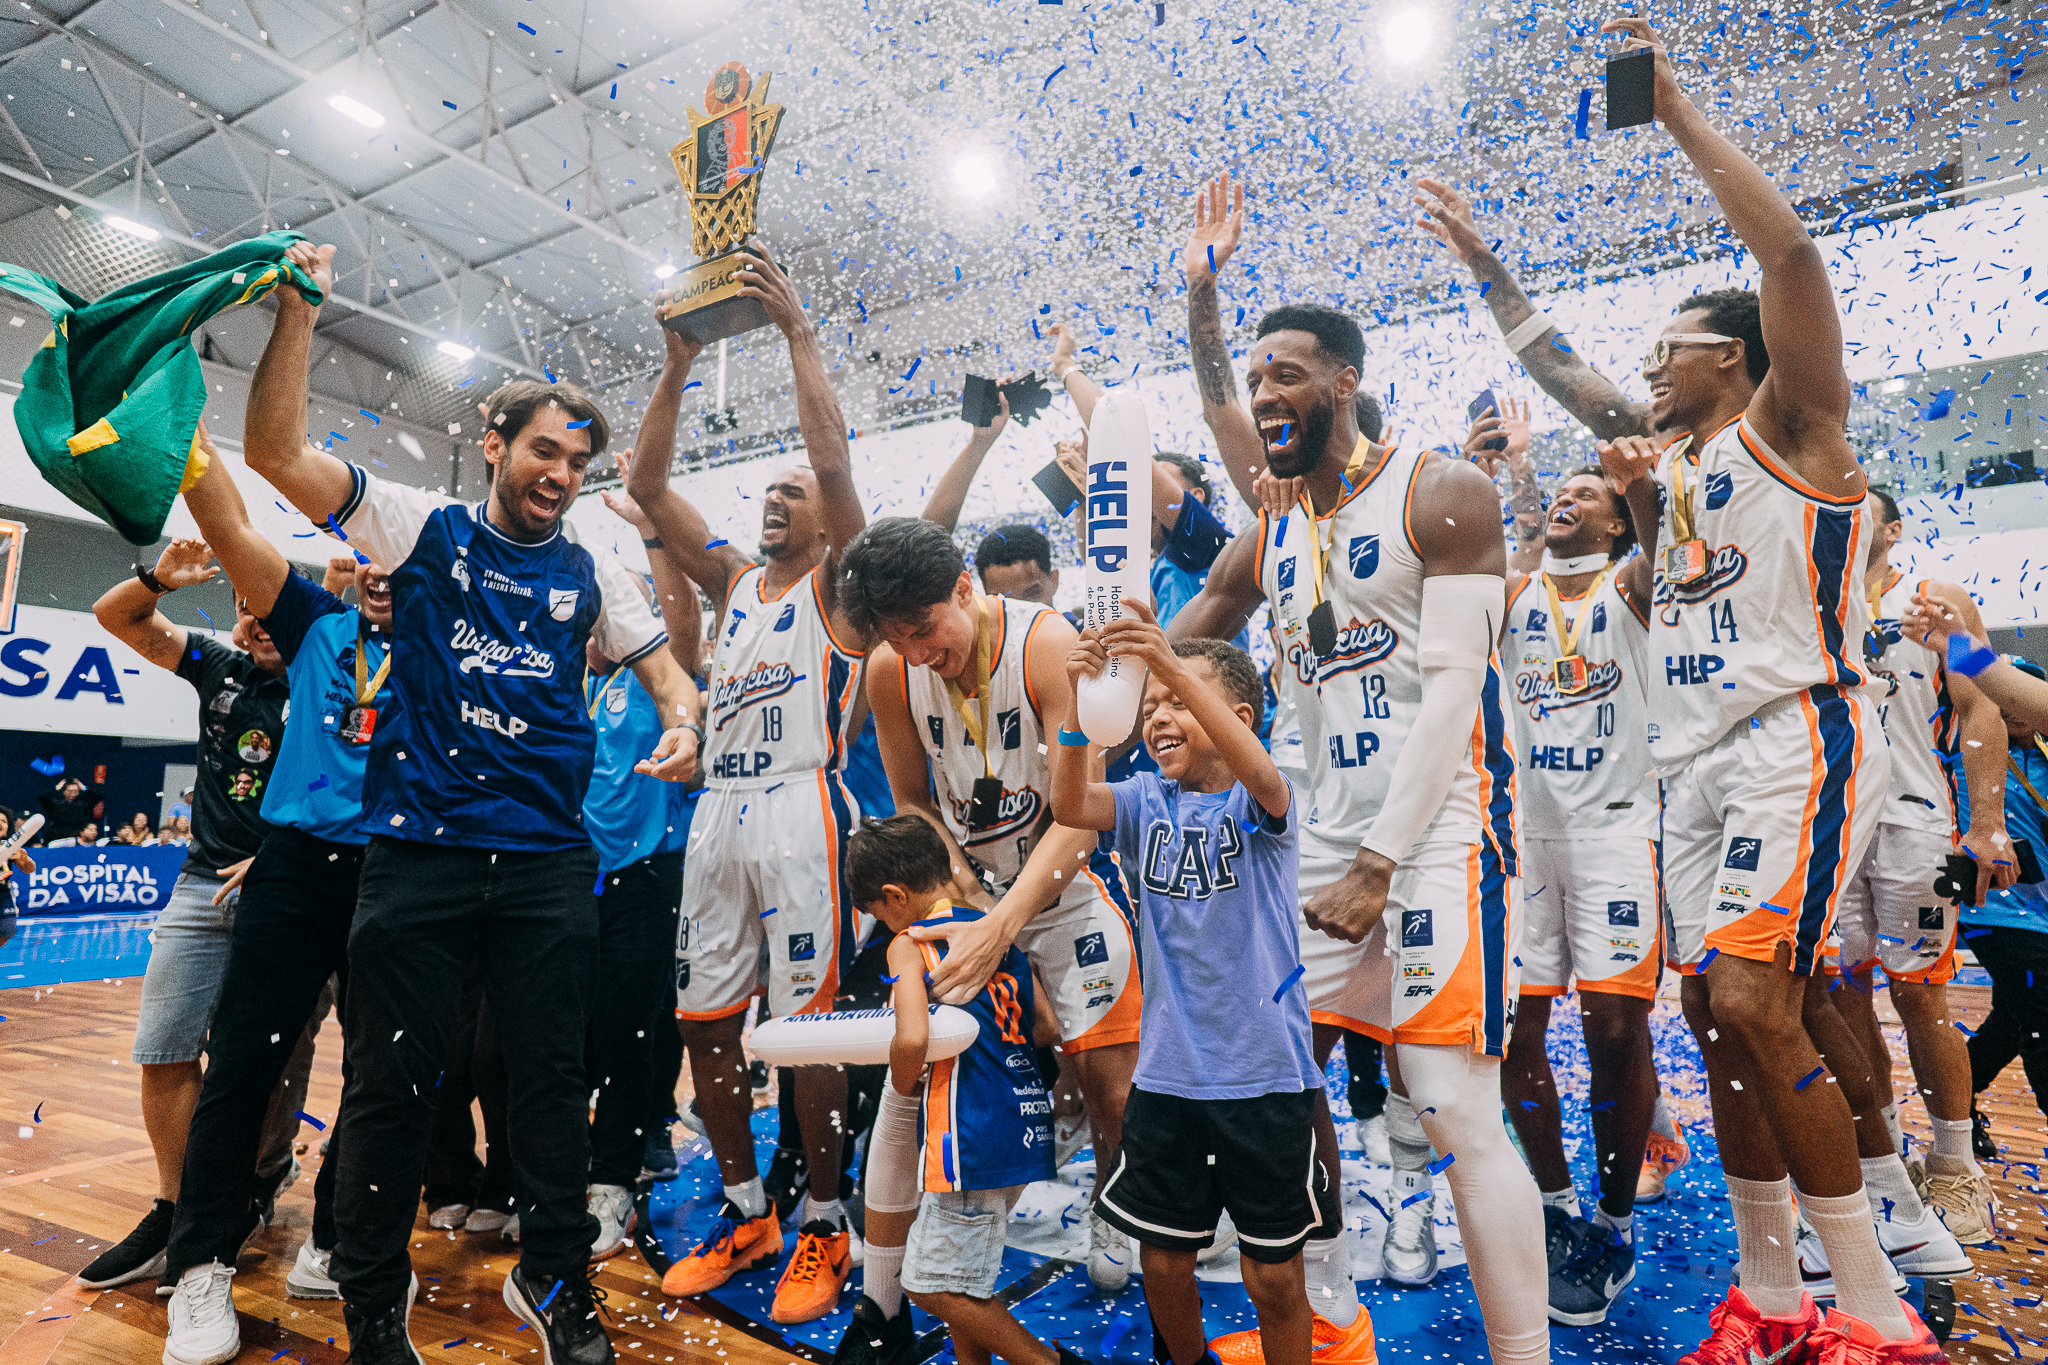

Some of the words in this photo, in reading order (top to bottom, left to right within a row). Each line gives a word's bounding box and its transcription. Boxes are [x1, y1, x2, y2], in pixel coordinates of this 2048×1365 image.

[1088, 460, 1129, 574] HELP
[488, 580, 509, 593] MESMA
[1096, 585, 1104, 593] e
[1708, 599, 1740, 644] 14
[1360, 674, 1391, 720] 12
[461, 700, 529, 740] HELP
[761, 705, 783, 743] 18
[1596, 701, 1615, 738] 10
[1529, 745, 1604, 772] HELP
[27, 887, 70, 909] DA
[78, 880, 159, 906] VISÃO
[28, 863, 158, 889] HOSPITAL
